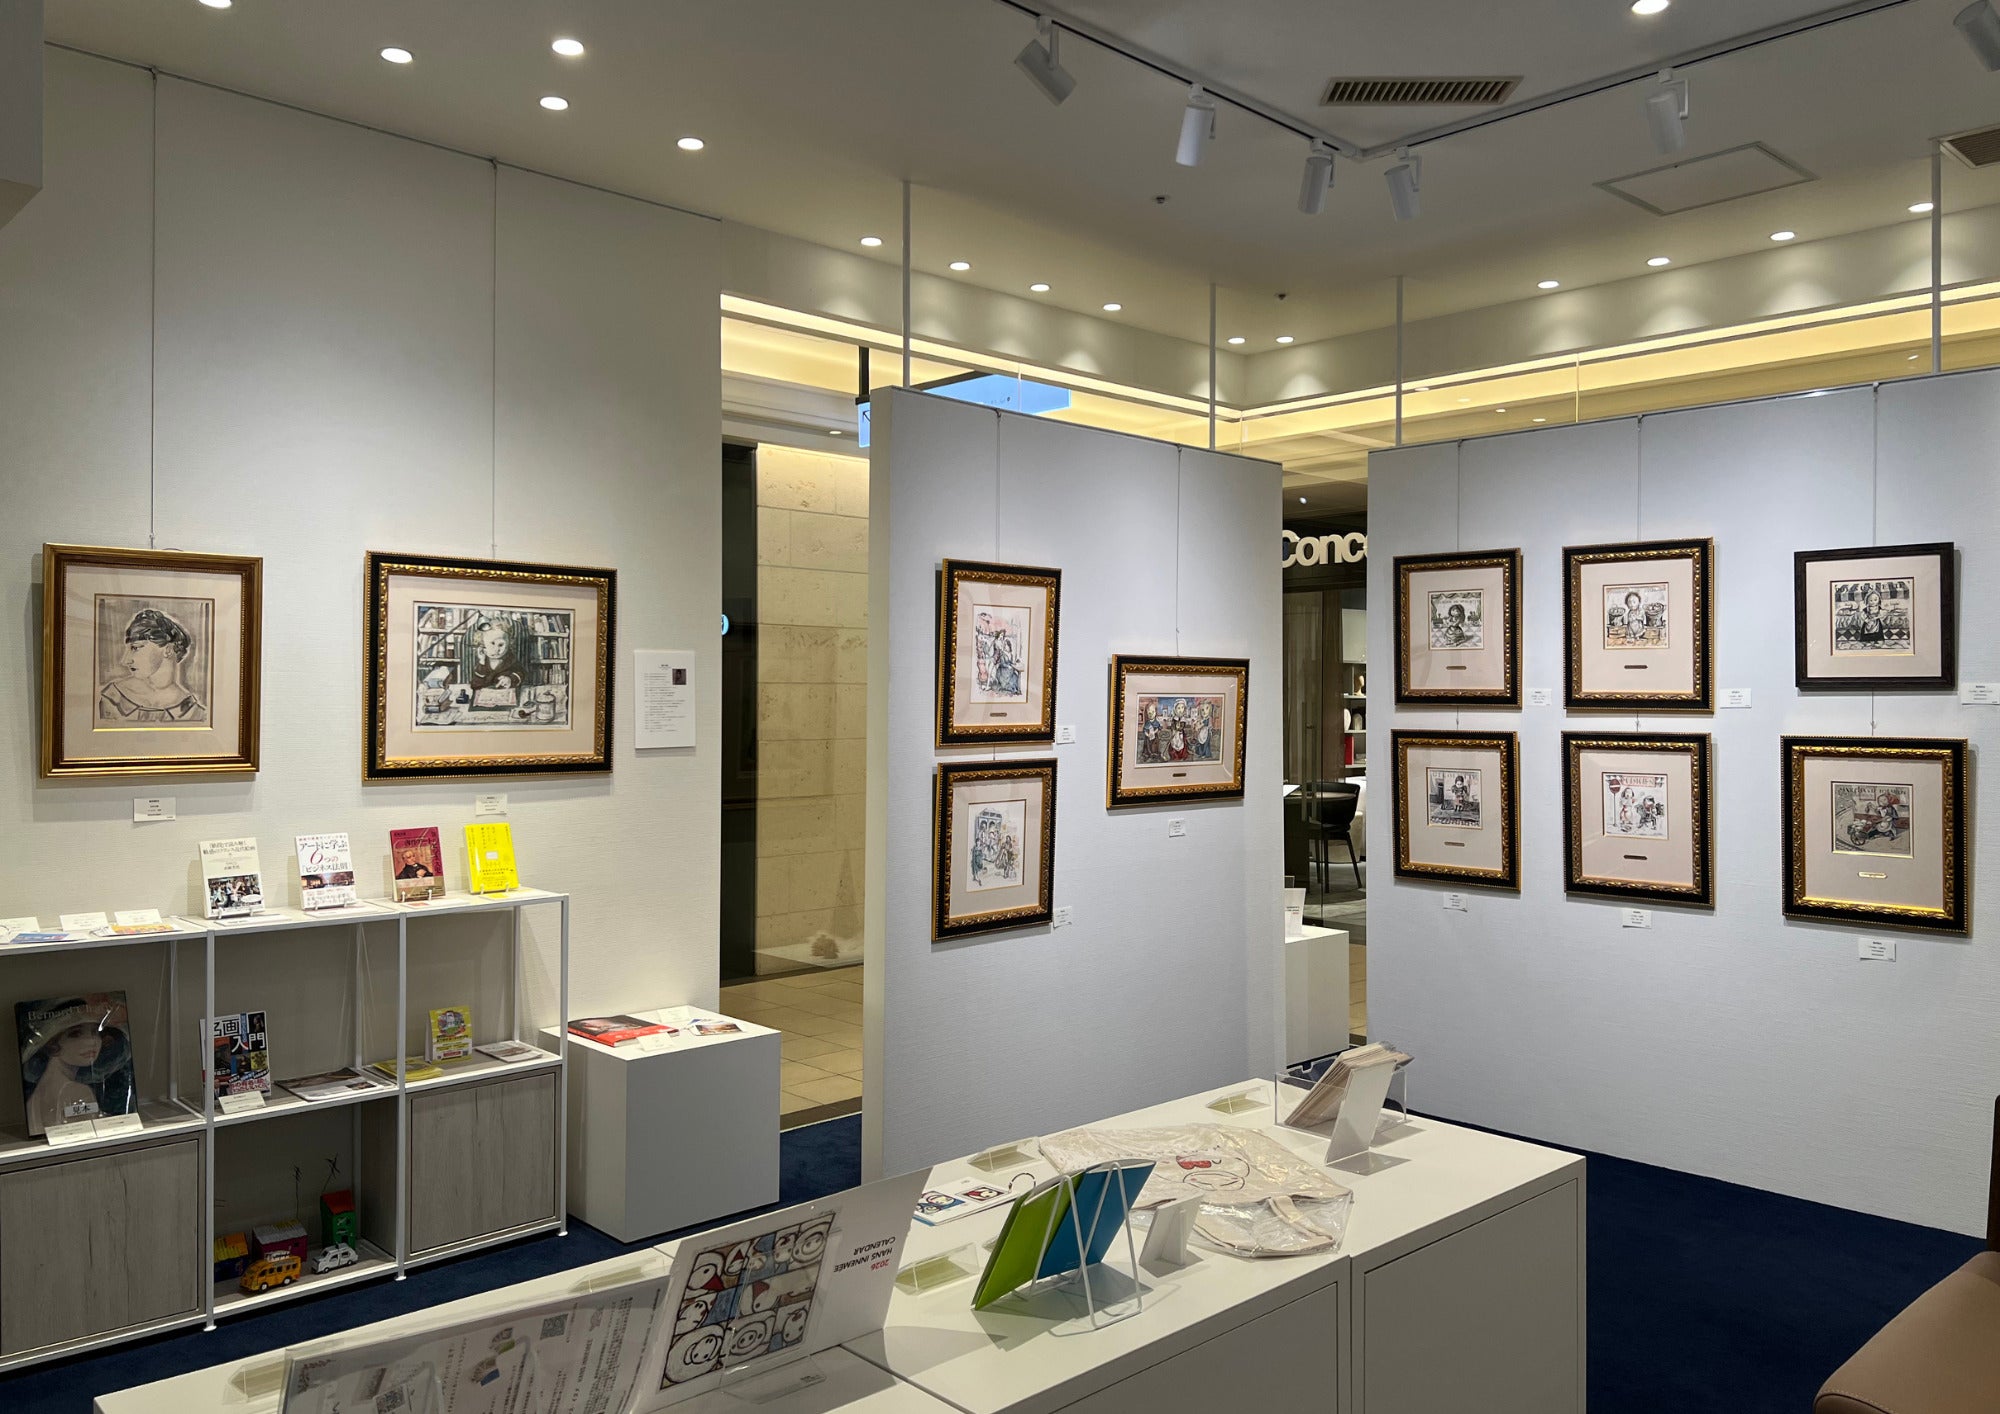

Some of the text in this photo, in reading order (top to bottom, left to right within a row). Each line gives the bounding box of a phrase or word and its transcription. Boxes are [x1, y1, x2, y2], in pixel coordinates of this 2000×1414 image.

[1283, 530, 1367, 568] Conc
[299, 839, 348, 851] アートに学ぶ
[231, 1032, 266, 1053] 入門
[72, 1104, 92, 1115] 見本
[853, 1236, 896, 1256] CALENDAR
[871, 1247, 893, 1261] HANS
[870, 1259, 890, 1271] 2026
